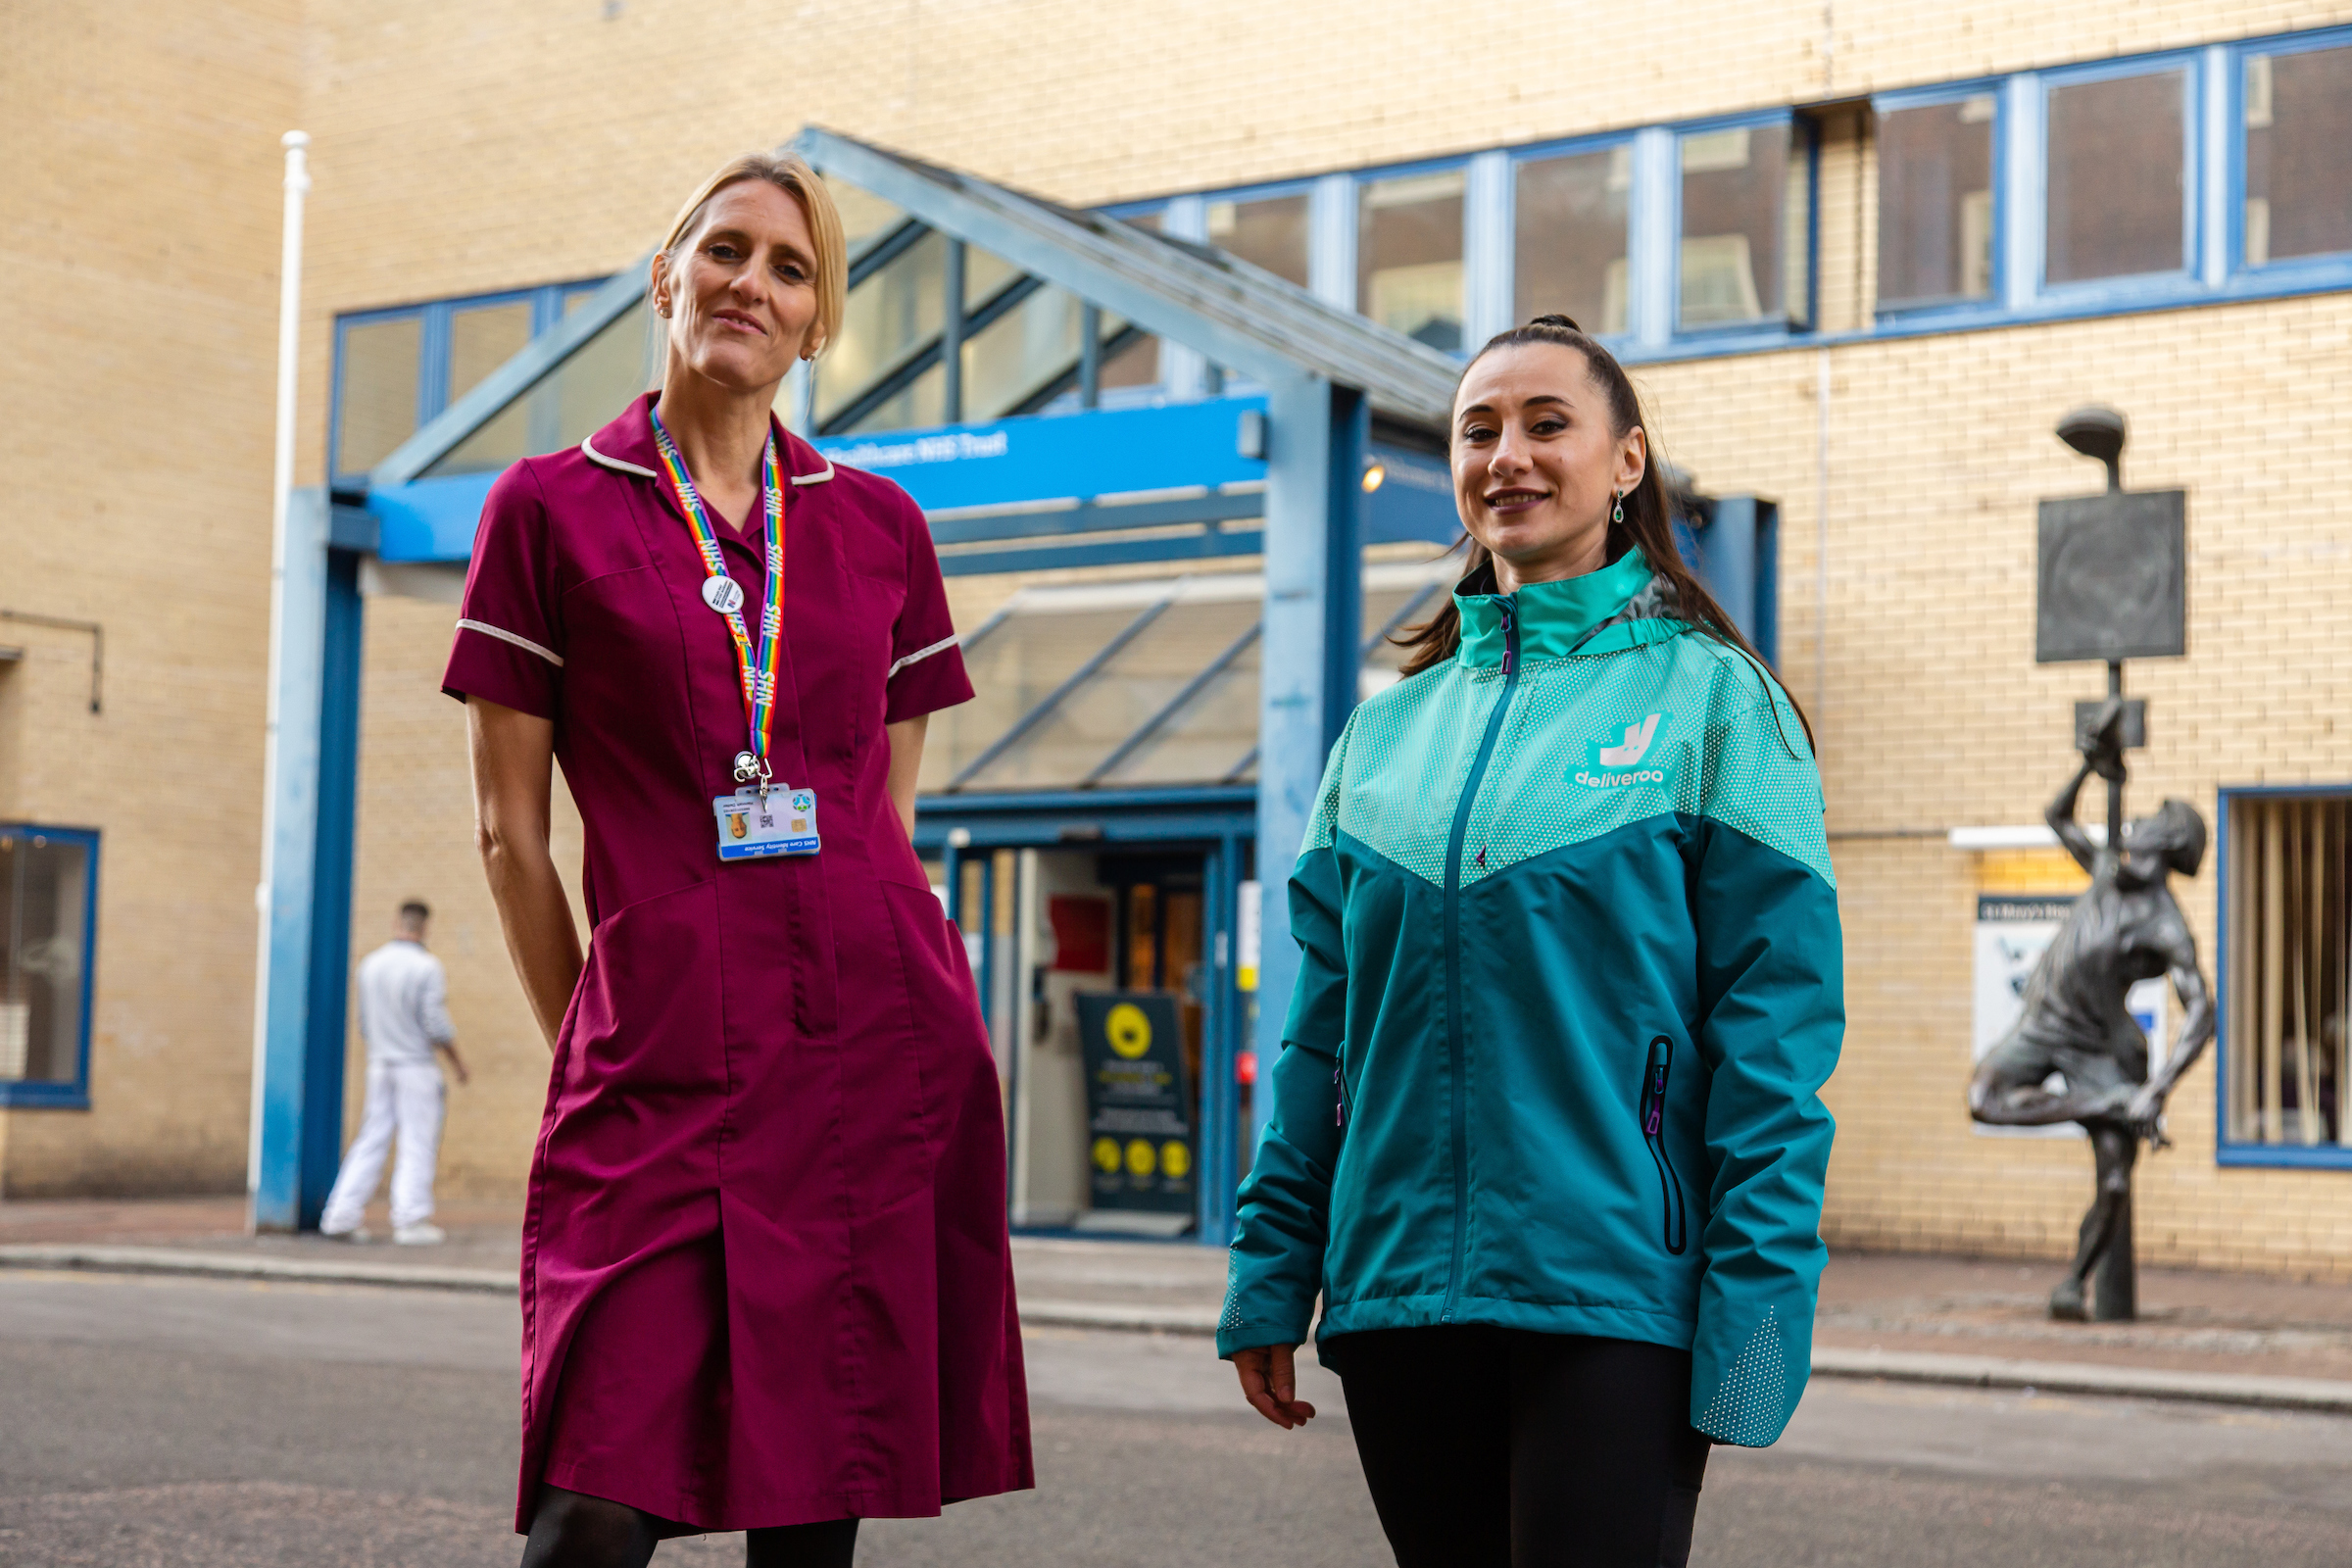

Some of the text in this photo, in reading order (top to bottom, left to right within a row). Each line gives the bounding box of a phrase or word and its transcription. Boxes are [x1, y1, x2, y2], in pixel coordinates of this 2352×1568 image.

[655, 428, 678, 459] NHS
[675, 482, 702, 512] NHS
[765, 486, 782, 517] NHS
[698, 539, 725, 571] NHS
[767, 542, 783, 577] NHS
[727, 610, 748, 635] HS
[762, 603, 781, 639] NHS
[756, 669, 775, 707] NHS
[1575, 770, 1664, 788] deliveroo
